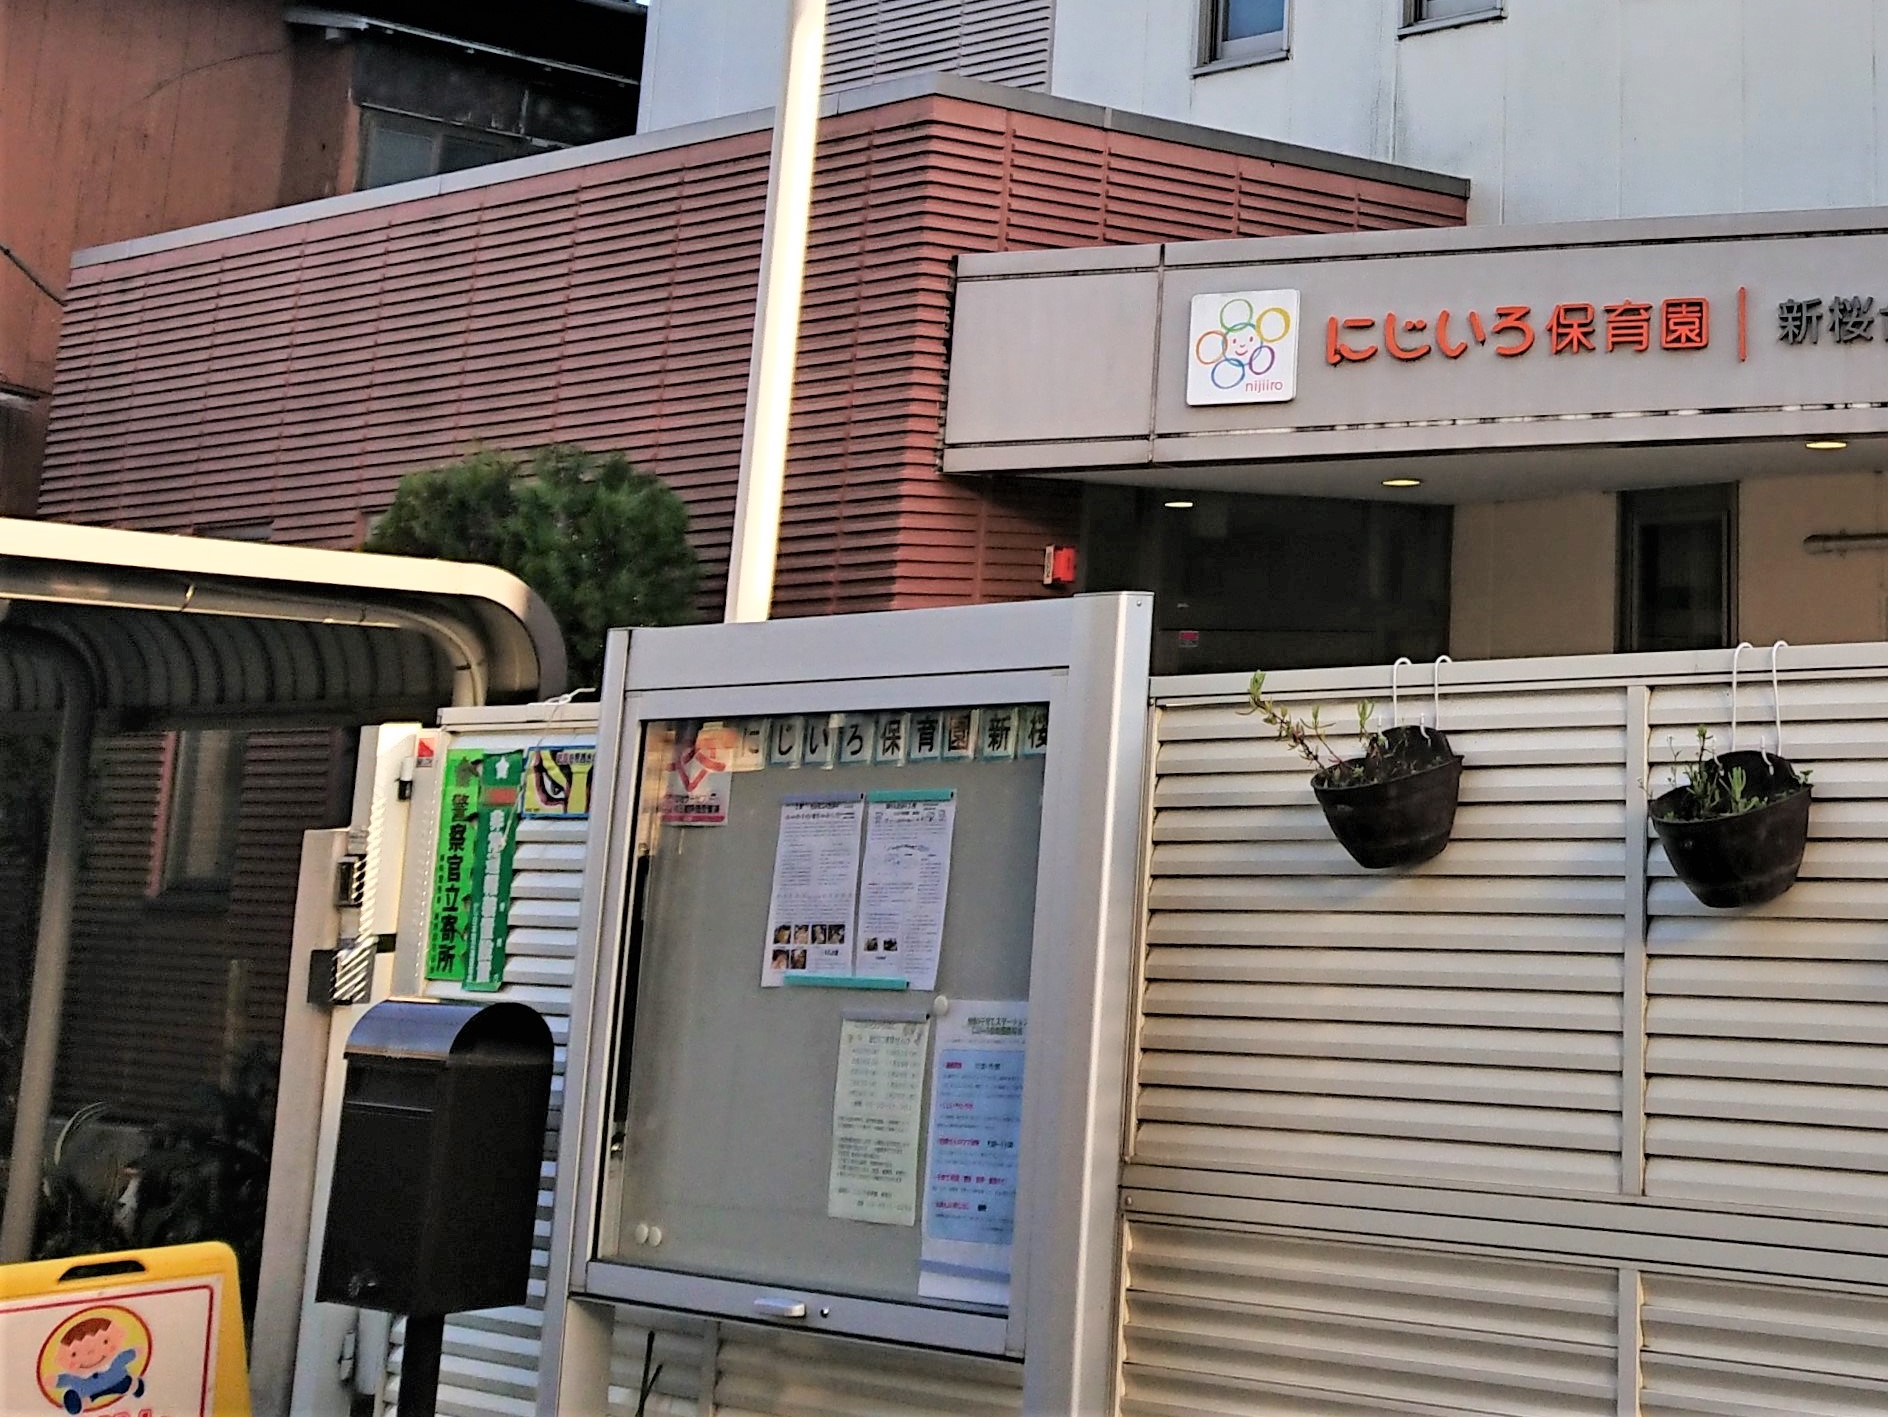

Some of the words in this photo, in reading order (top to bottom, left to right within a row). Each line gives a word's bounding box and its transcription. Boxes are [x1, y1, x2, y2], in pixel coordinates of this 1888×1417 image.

[1325, 295, 1710, 366] にじいろ保育園
[1245, 379, 1283, 394] nijiiro
